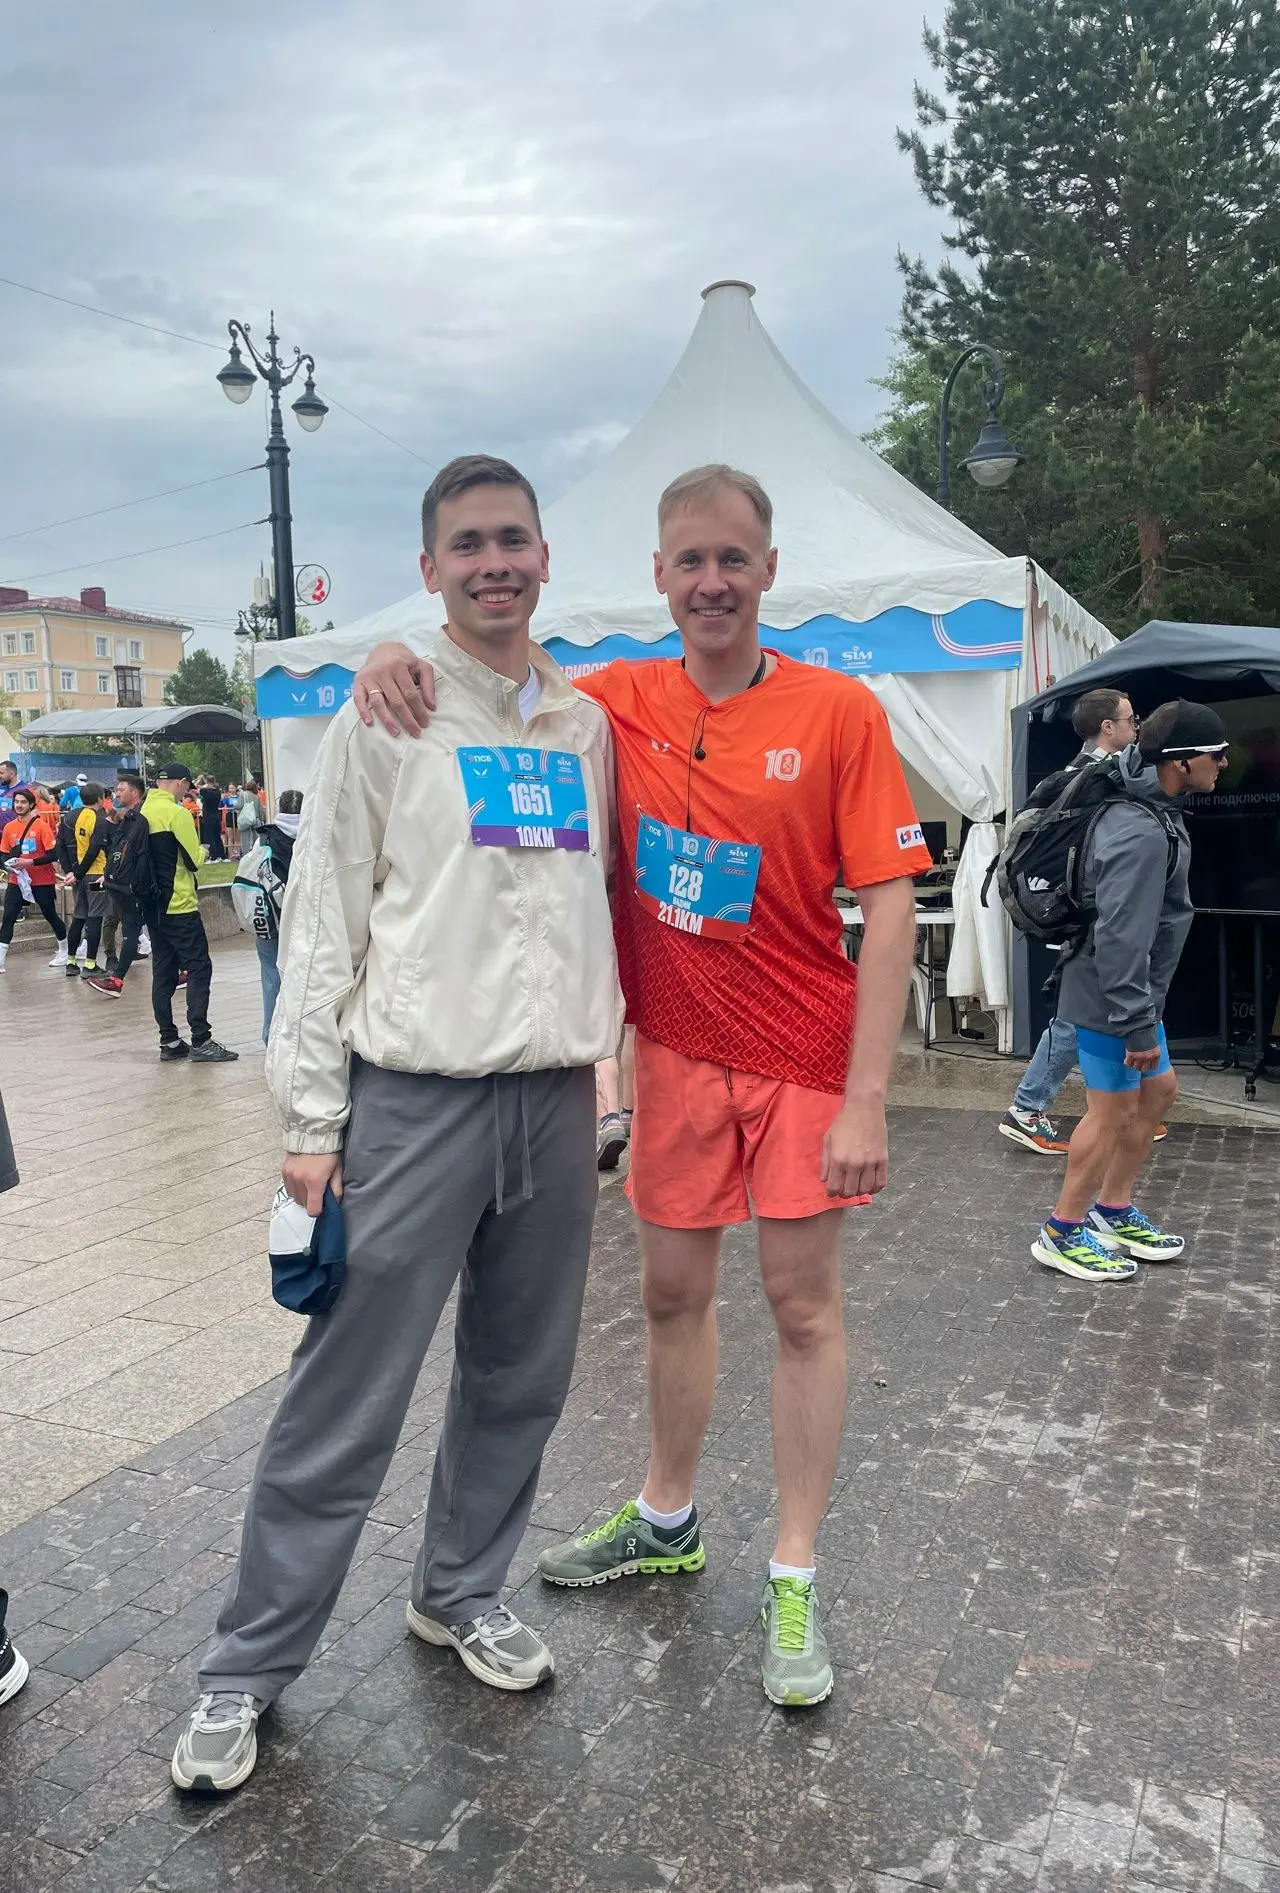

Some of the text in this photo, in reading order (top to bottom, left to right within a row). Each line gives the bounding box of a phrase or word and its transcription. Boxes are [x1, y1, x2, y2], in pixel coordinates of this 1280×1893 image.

[802, 647, 828, 667] 10
[317, 685, 335, 708] 10
[474, 755, 492, 763] ПСБ
[516, 753, 534, 771] 10
[764, 747, 802, 782] 10
[508, 782, 553, 816] 1651
[1197, 796, 1211, 806] не
[516, 826, 555, 848] 10KM
[682, 836, 700, 856] 10
[668, 863, 704, 902] 128
[657, 901, 704, 936] 21.1KM
